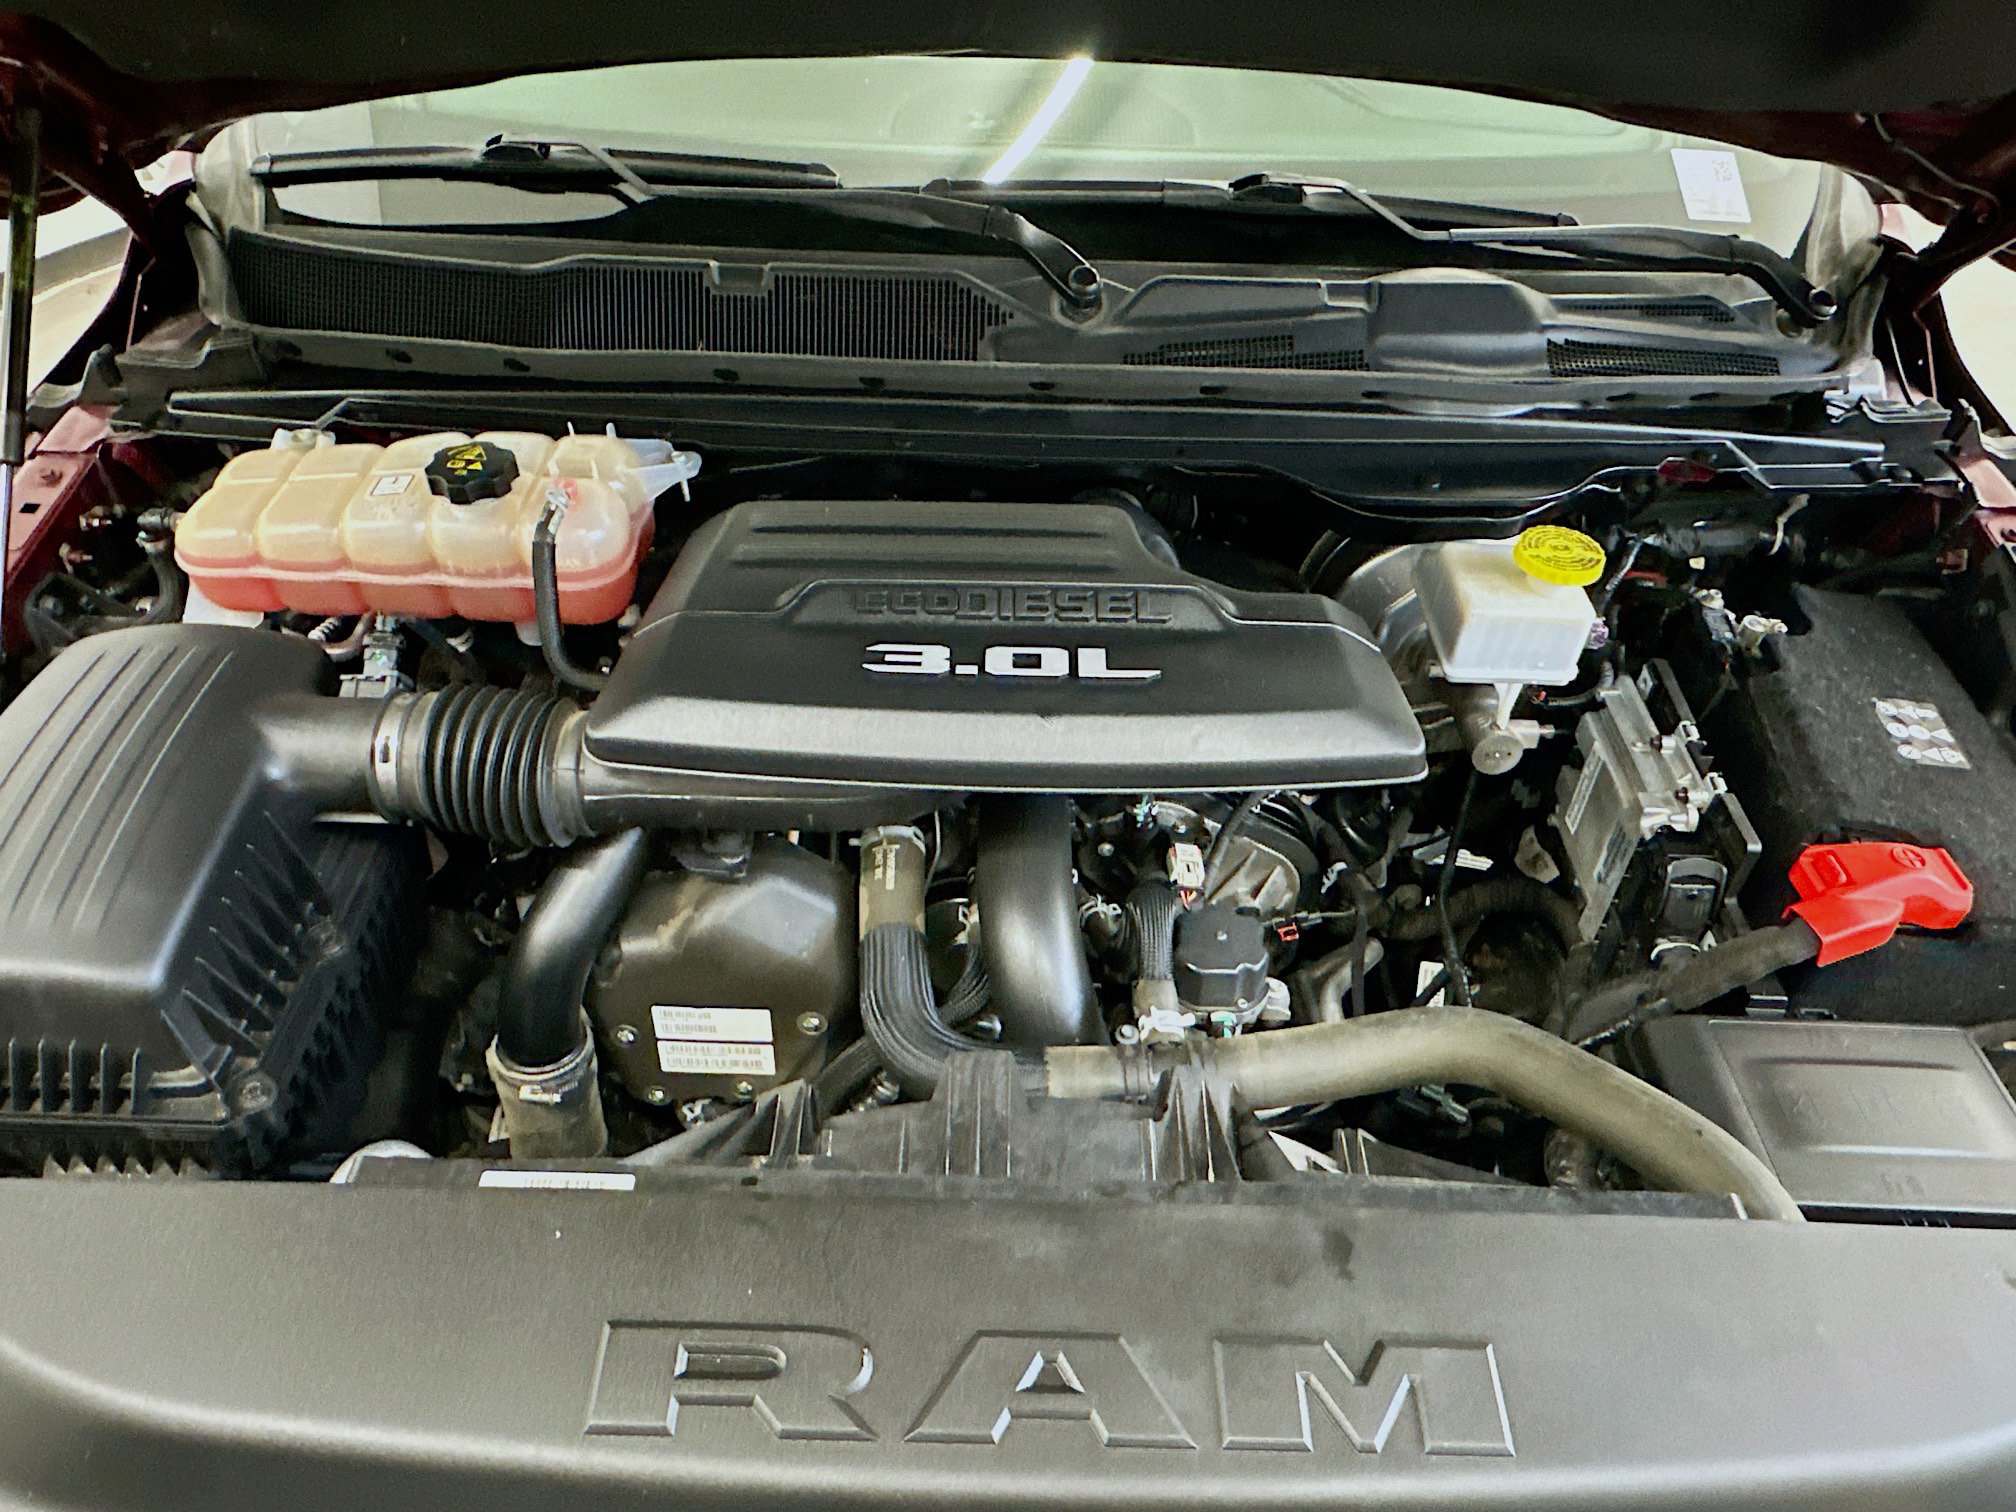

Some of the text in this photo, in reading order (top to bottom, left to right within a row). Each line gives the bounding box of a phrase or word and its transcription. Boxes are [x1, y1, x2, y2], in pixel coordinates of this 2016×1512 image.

[855, 588, 1173, 625] ECODIESEL
[861, 642, 1163, 680] 3.0L
[582, 1317, 1518, 1457] RAM
